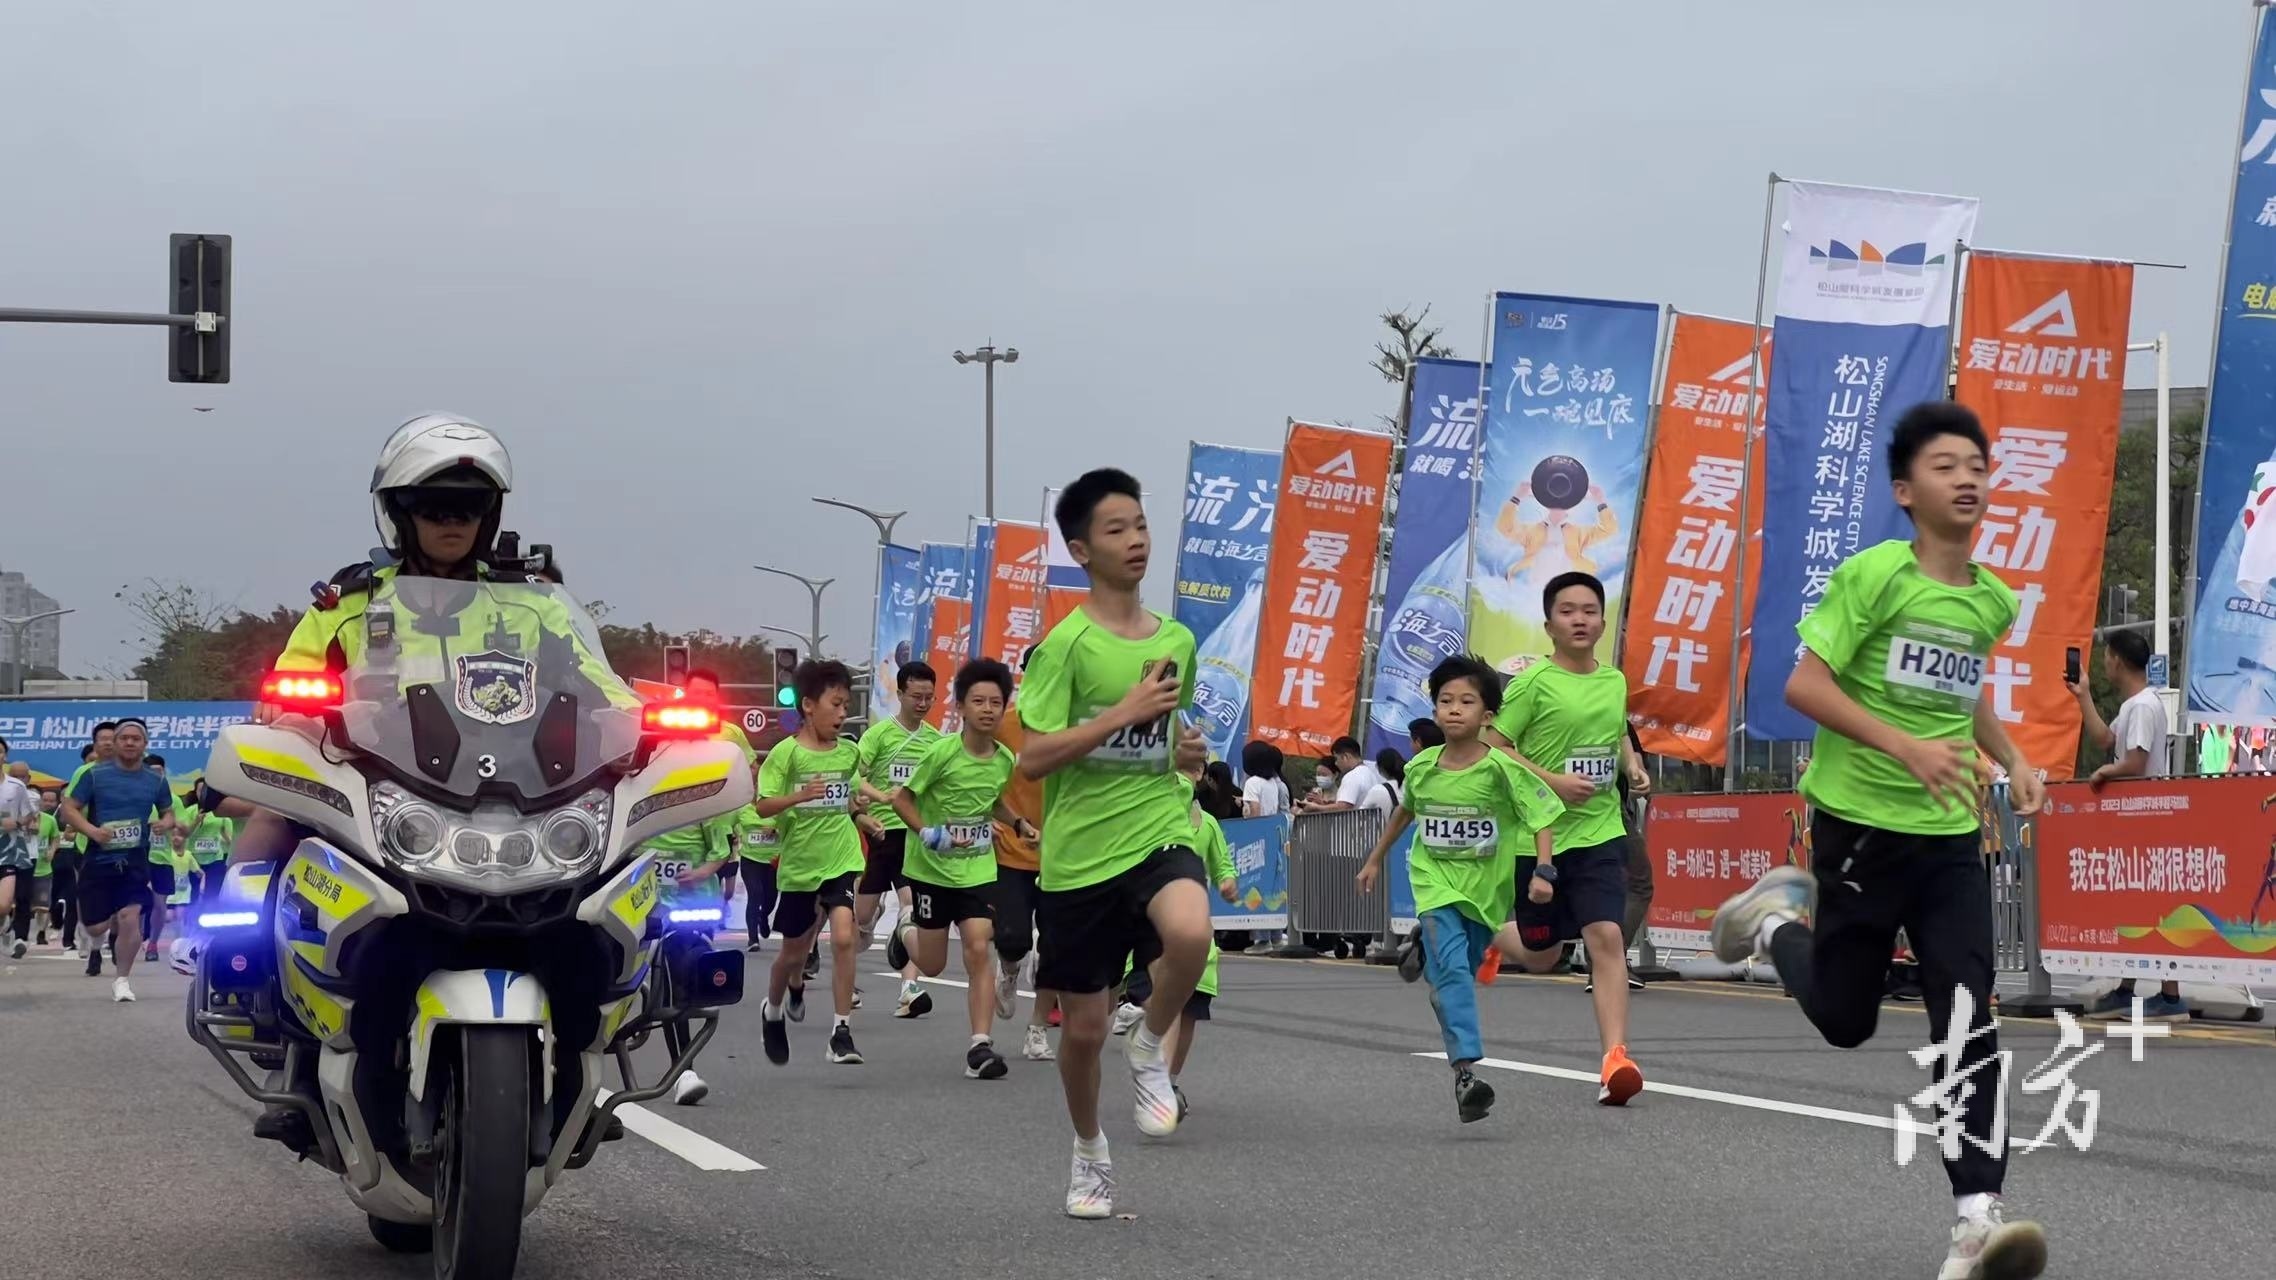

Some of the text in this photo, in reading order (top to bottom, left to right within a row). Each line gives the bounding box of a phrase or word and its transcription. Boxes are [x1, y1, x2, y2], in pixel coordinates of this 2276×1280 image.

[1966, 337, 2112, 380] 爱动时代
[1845, 355, 1889, 554] SONGSHAN LAKE SCIENCE CITY
[1288, 475, 1377, 506] 爱动时代
[1178, 580, 1232, 600] 电解质饮料
[1644, 454, 1746, 693] 爱动时代
[1278, 529, 1350, 709] 爱动时代
[1900, 643, 1982, 687] H2005
[746, 713, 764, 728] 60
[170, 739, 200, 750] CITY
[478, 754, 497, 778] 3
[1425, 818, 1494, 839] H1459
[1666, 848, 1716, 879] 跑一场松马
[2068, 845, 2227, 894] 我在松山湖很想你
[303, 863, 343, 904] 松山湖分局
